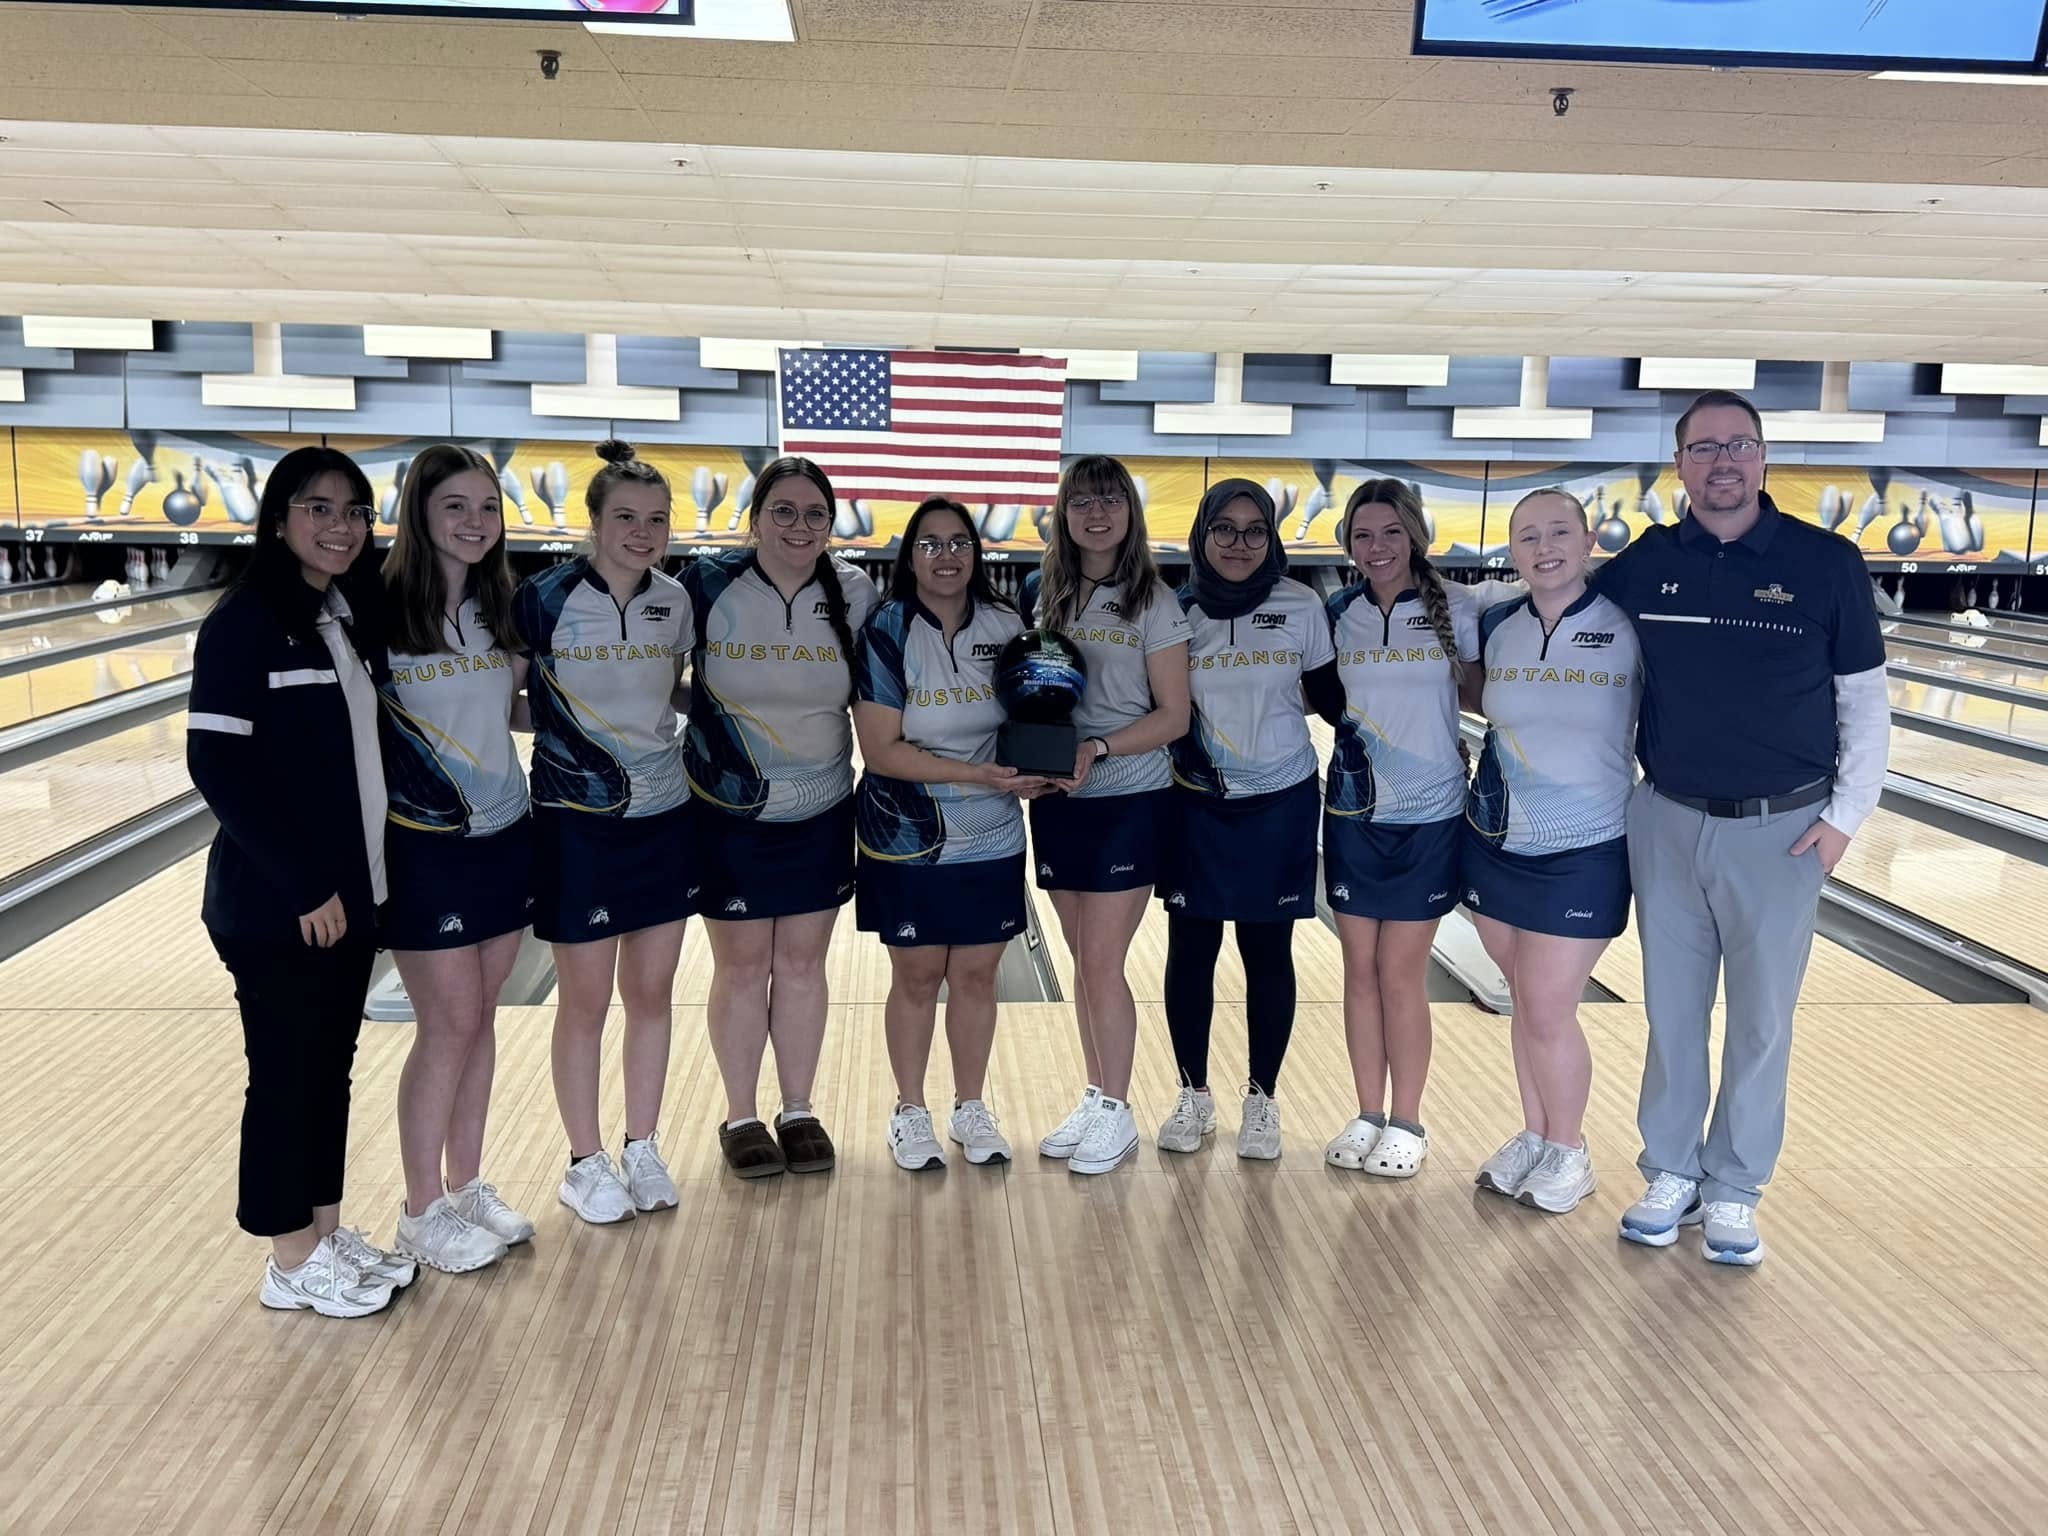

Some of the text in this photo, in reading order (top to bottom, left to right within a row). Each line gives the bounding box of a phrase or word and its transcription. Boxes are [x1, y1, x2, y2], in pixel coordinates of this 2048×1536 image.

[25, 530, 44, 542] 37
[79, 532, 113, 541] AMF
[180, 533, 198, 544] 38
[232, 535, 256, 544] AM
[540, 542, 573, 551] AMF
[689, 546, 721, 555] AMF
[834, 549, 866, 558] AMF
[1487, 557, 1505, 568] 47
[1901, 562, 1918, 573] 50
[1947, 563, 1977, 572] AMF
[640, 605, 671, 618] STORM
[1101, 601, 1121, 613] STO
[1251, 613, 1287, 626] STORM
[1064, 626, 1140, 648] TANGS
[1571, 631, 1616, 644] STORM
[552, 643, 673, 661] MUSTANG
[706, 640, 838, 663] MUSTAN
[1339, 646, 1445, 666] USTANG
[1187, 650, 1299, 672] USTANGS
[392, 651, 513, 685] MUSTANG
[1487, 667, 1628, 688] USTANGS
[907, 683, 997, 706] USTAN
